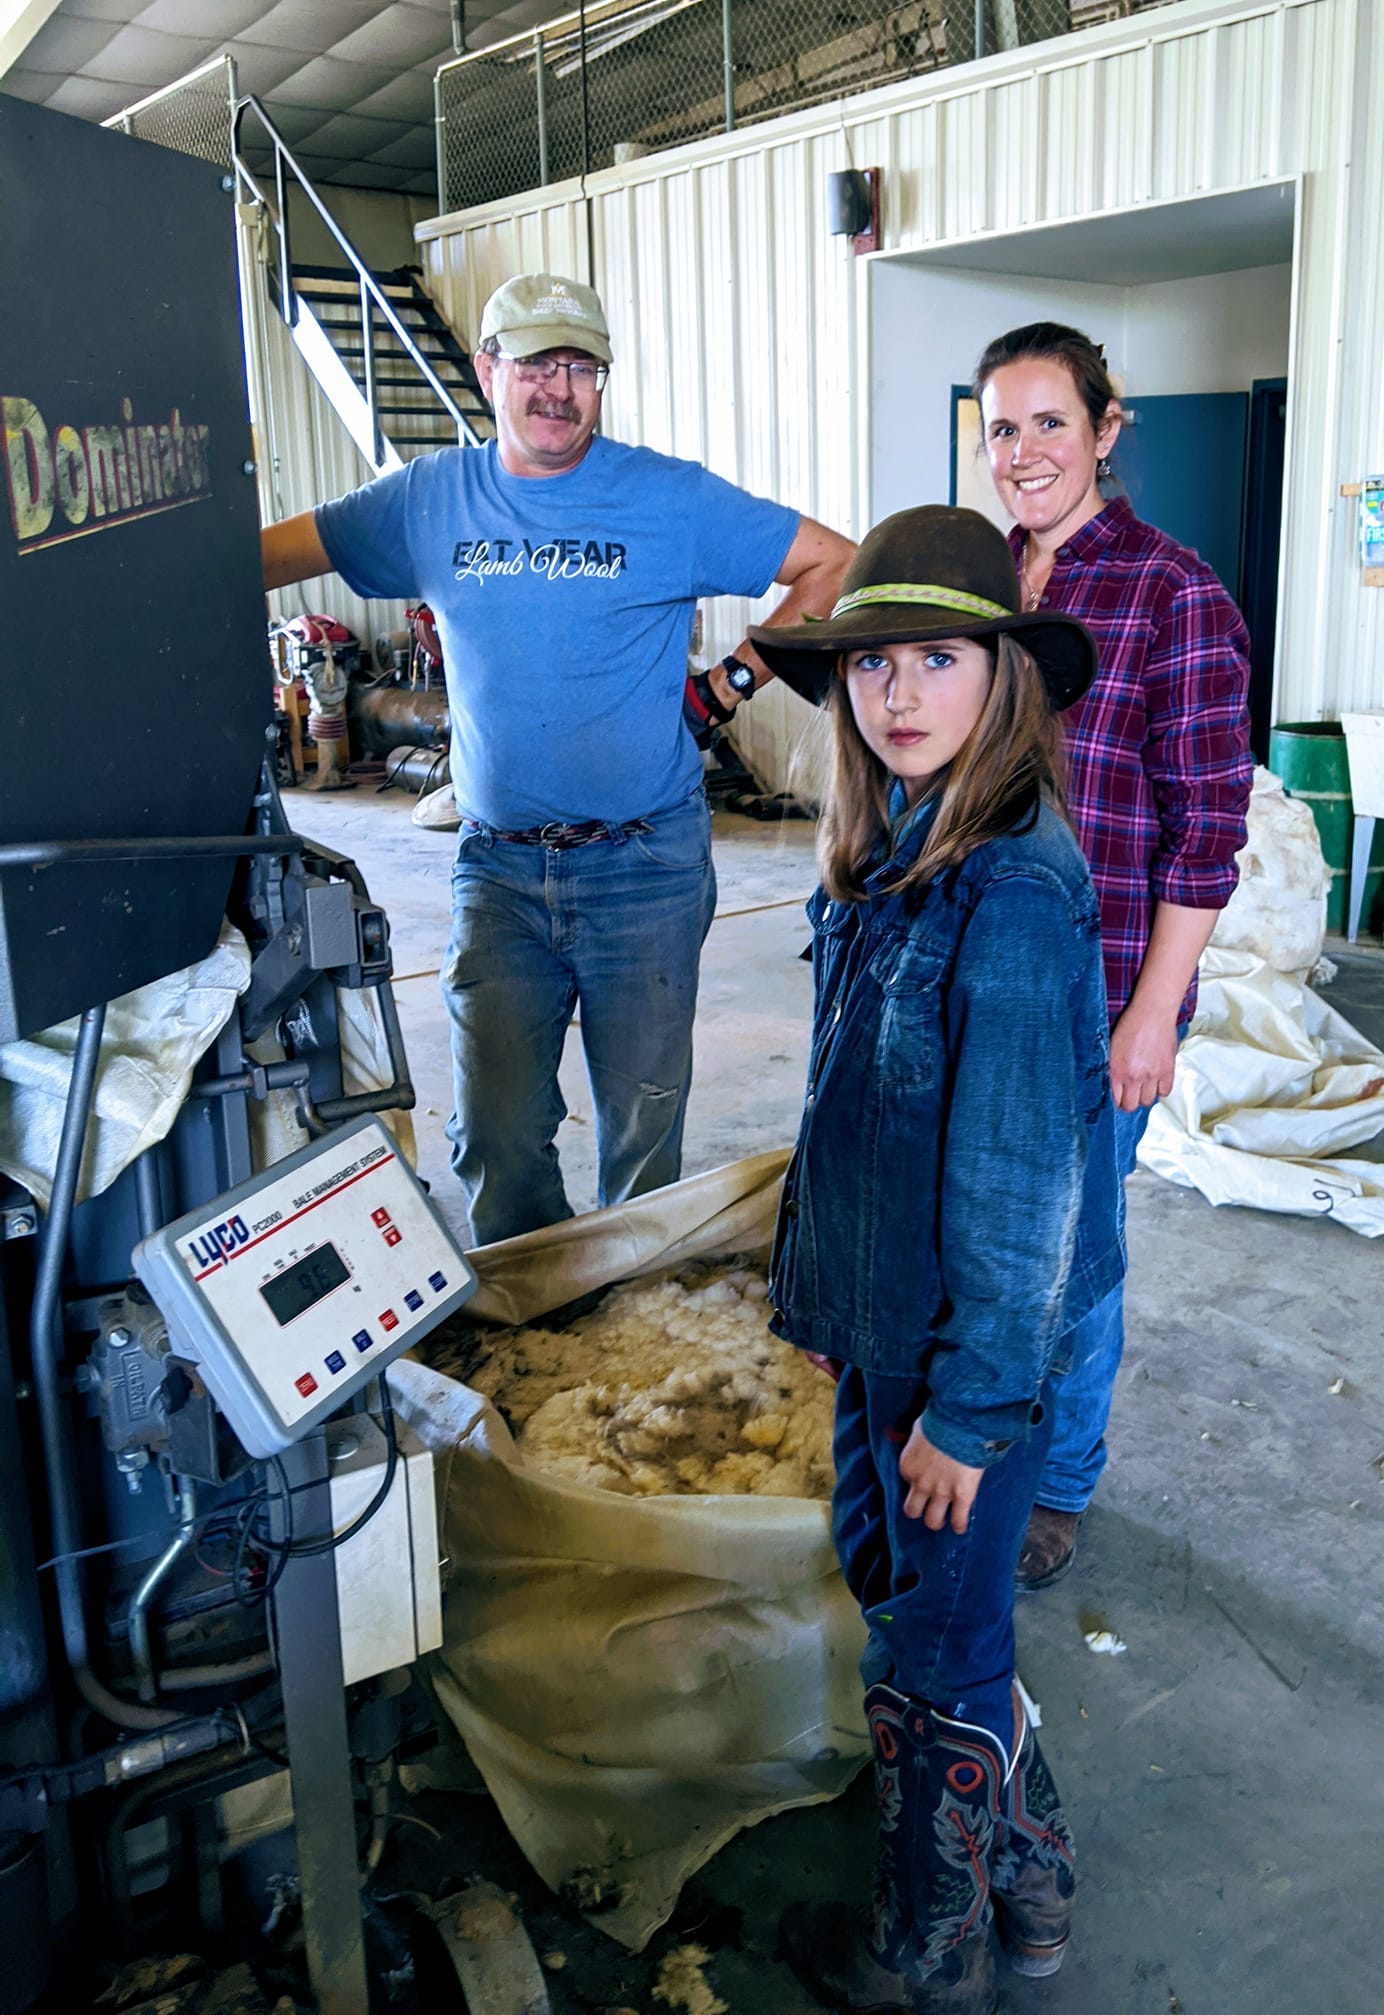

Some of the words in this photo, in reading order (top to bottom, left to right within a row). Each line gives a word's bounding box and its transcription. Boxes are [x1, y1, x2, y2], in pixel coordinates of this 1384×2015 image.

[455, 542, 525, 587] Lamb
[530, 543, 622, 581] Wool
[292, 1190, 314, 1209] BALE
[311, 1161, 360, 1196] MANAGEMENT
[360, 1145, 388, 1168] SYSTEM
[251, 1210, 283, 1234] PC2000
